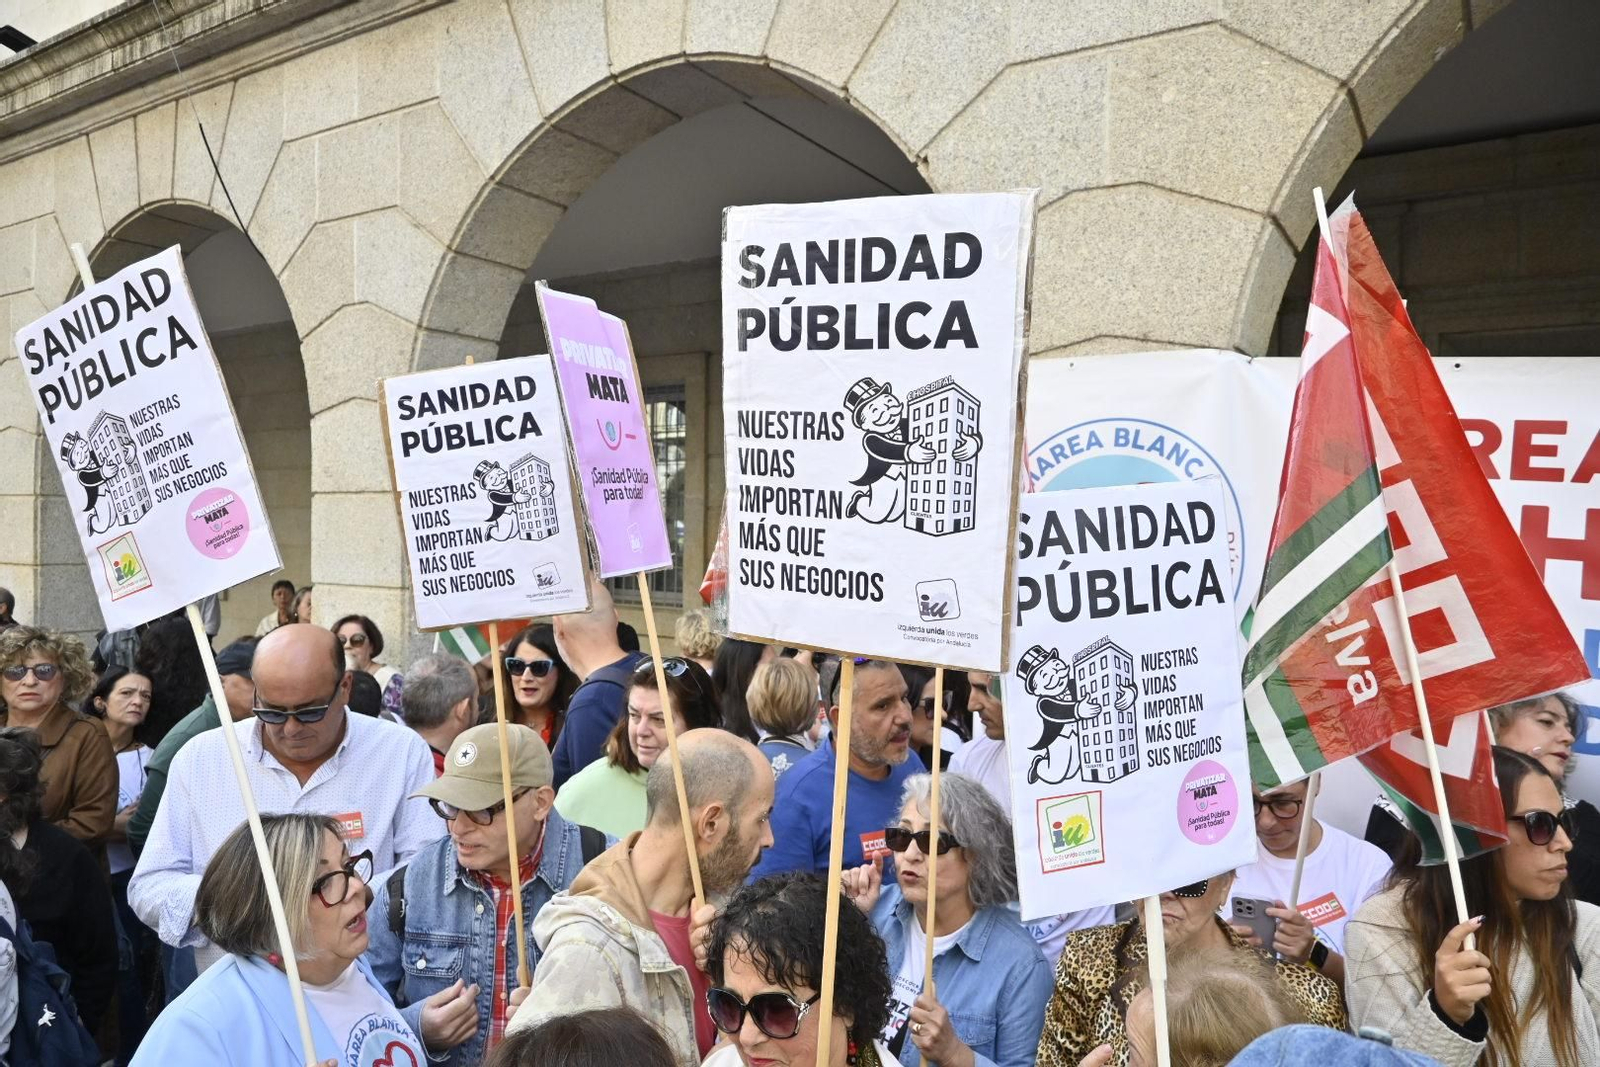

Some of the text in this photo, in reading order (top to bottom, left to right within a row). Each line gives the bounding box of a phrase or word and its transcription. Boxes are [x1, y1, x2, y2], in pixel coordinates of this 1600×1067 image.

[737, 231, 983, 289] SANIDAD
[25, 267, 172, 375] SANIDAD
[737, 296, 980, 352] PÚBLICA
[38, 315, 198, 425] PÚBLICA
[397, 375, 537, 421] SANIDAD
[585, 372, 630, 404] MATA
[130, 394, 181, 427] NUESTRAS
[737, 409, 845, 442] NUESTRAS
[137, 422, 164, 447] VIDAS
[143, 432, 194, 465] IMPORTAN
[401, 411, 543, 458] PÚBLICA
[149, 454, 193, 484] MÁS QUE
[738, 447, 795, 479] VIDAS
[1030, 427, 1204, 481] AREA BLANC
[155, 462, 228, 503] SUS NEGOCIOS
[591, 465, 649, 488] ¡Sanidad Pública
[408, 482, 477, 508] NUESTRAS
[603, 488, 625, 504] para
[739, 484, 843, 520] IMPORTAN
[204, 507, 229, 524] MATA
[411, 509, 451, 531] VIDAS
[1019, 500, 1216, 560] SANIDAD
[415, 526, 484, 553] IMPORTAN
[739, 517, 826, 558] MÁS QUE
[419, 551, 476, 575] MÁS QUE
[422, 578, 447, 597] SUS
[450, 568, 515, 593] NEGOCIOS
[740, 558, 884, 603] SUS NEGOCIOS
[1017, 558, 1226, 627] PÚBLICA
[926, 626, 945, 636] unida
[1140, 646, 1199, 672] NUESTRAS
[1142, 669, 1177, 695] VIDAS
[1143, 693, 1204, 720] IMPORTAN
[1145, 717, 1198, 744] MÁS QUE
[1147, 736, 1222, 768] SUS NEGOCIOS
[1185, 773, 1227, 791] PRIVATIZAR
[1194, 785, 1218, 800] MATA
[1194, 822, 1207, 831] para
[347, 1028, 367, 1067] AREA
